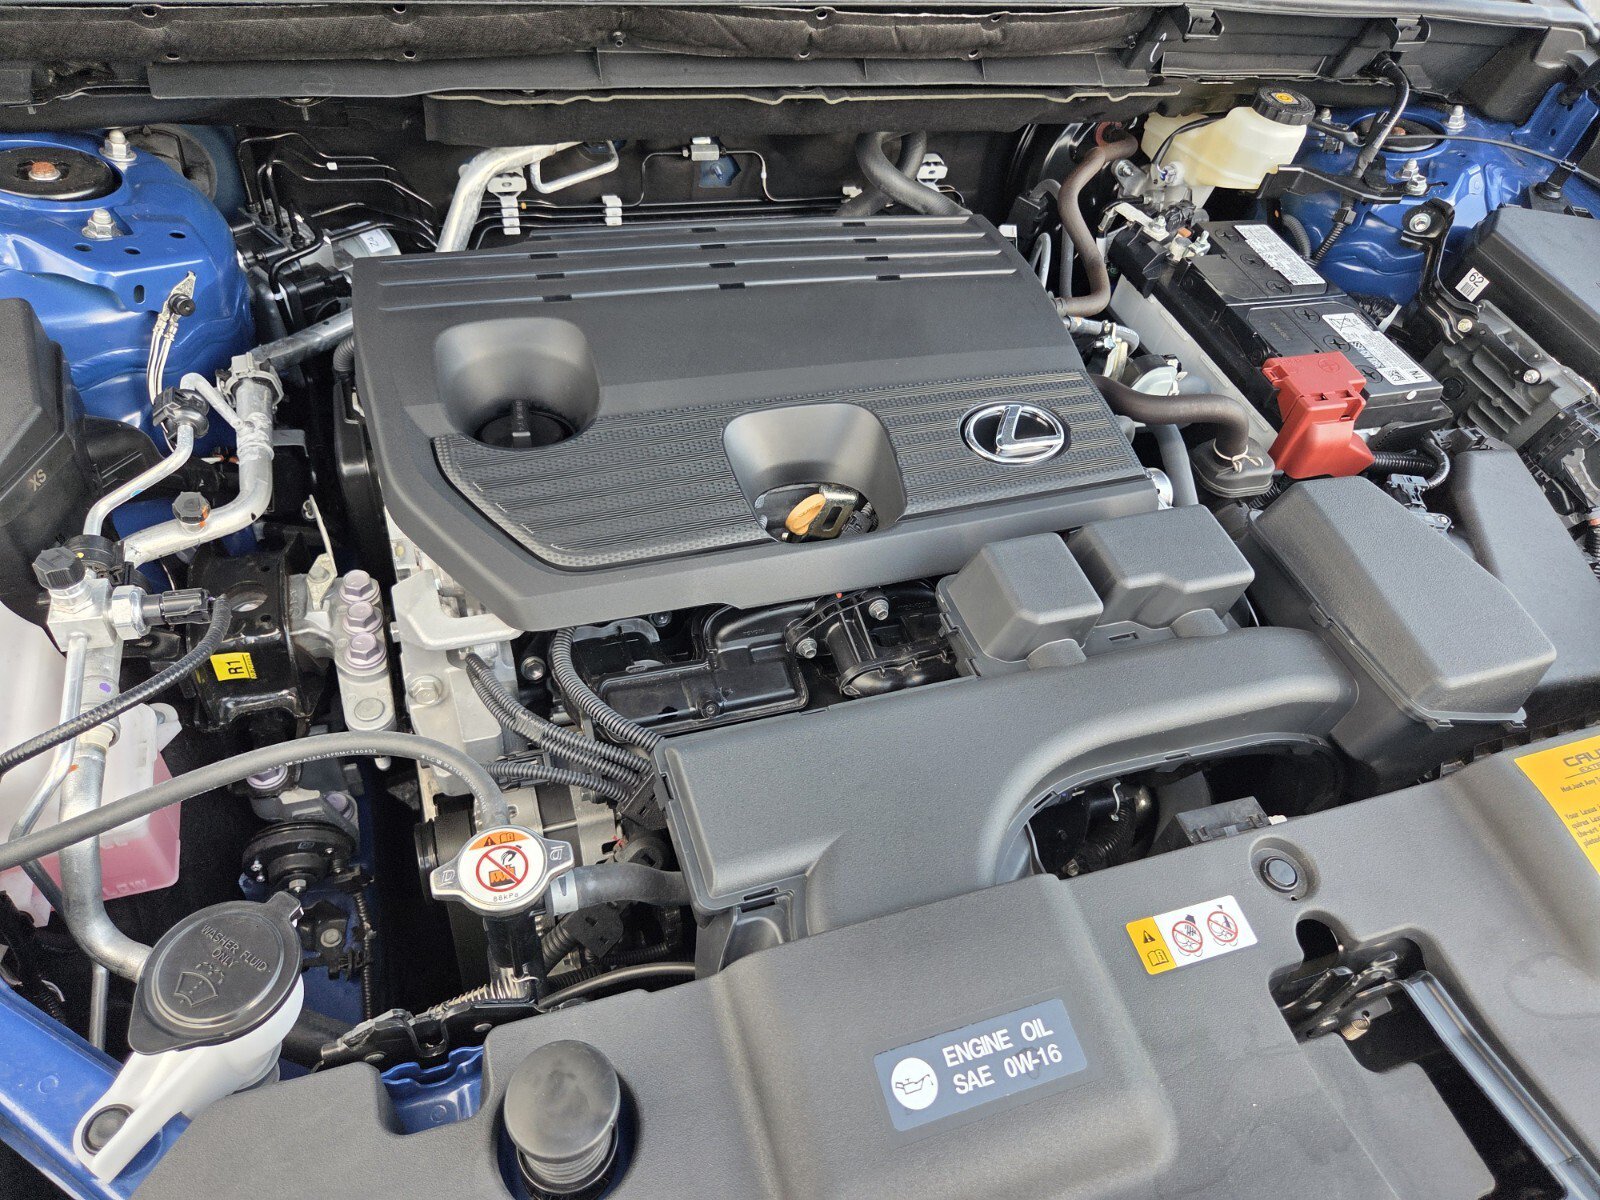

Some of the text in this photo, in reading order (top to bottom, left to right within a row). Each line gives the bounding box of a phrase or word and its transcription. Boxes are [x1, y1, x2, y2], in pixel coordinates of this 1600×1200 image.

[1469, 272, 1485, 288] 62
[30, 469, 47, 491] XS
[225, 660, 244, 675] R1
[1580, 807, 1597, 815] Lexus
[493, 892, 519, 902] 88kPa
[201, 924, 268, 972] WASHER FLUID
[212, 948, 234, 969] ONLY
[942, 1018, 1055, 1068] ENGINE OIL
[953, 1043, 1063, 1095] SAE 0W-16
